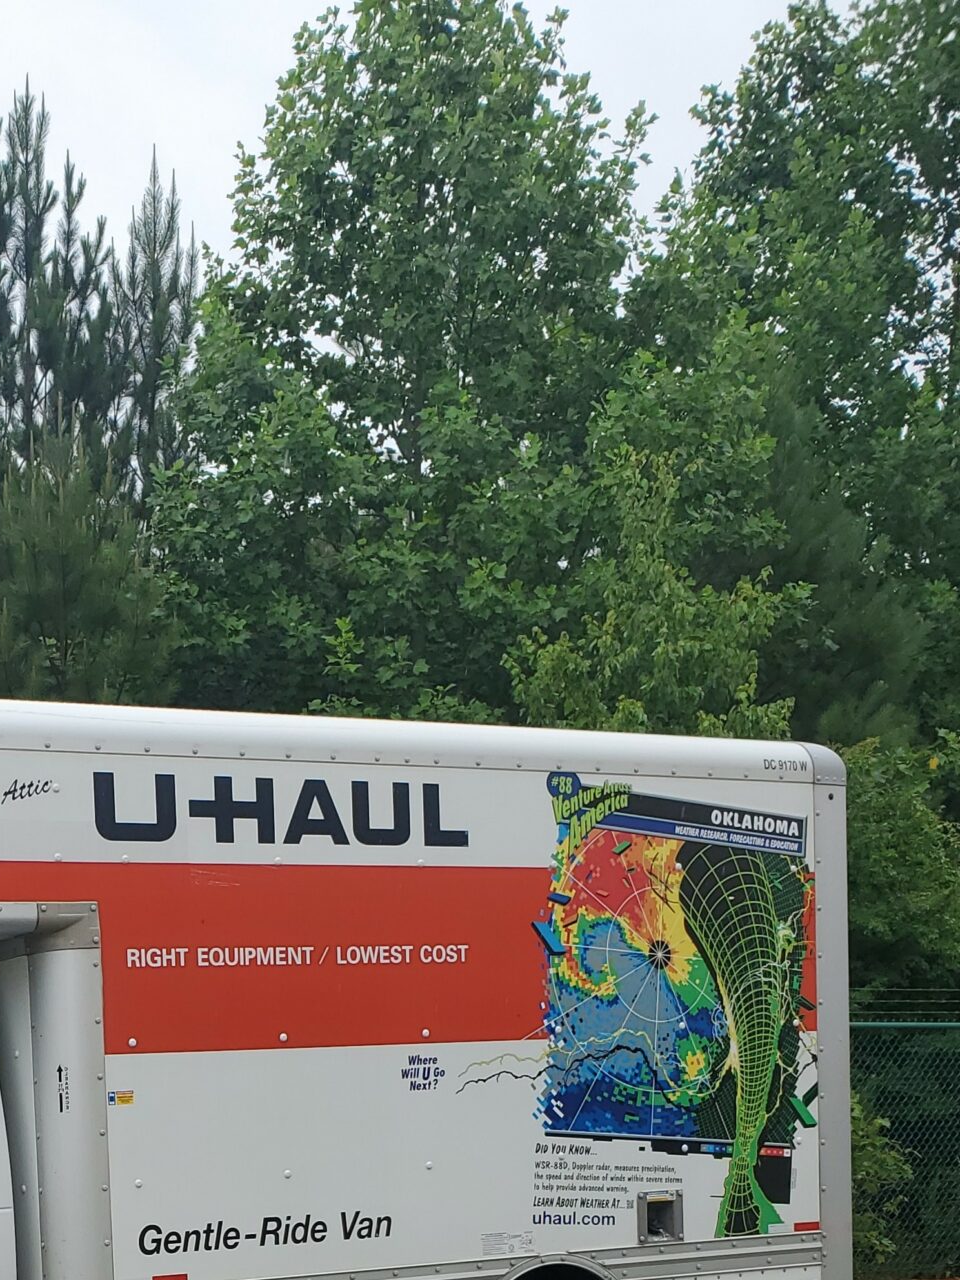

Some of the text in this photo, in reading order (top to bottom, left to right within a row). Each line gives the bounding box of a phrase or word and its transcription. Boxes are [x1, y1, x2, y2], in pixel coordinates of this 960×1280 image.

[764, 759, 808, 772] DC 9170 W
[1, 779, 51, 805] Attic
[551, 776, 573, 794] #88
[552, 787, 602, 823] Venture
[570, 794, 629, 854] America
[711, 810, 799, 836] OKLAHOMA
[675, 826, 700, 837] WEATHER
[126, 948, 188, 969] RIGHT
[197, 946, 312, 967] EQUIPMENT
[336, 945, 414, 965] LOWEST
[420, 944, 469, 963] COST
[408, 1054, 438, 1065] Where
[401, 1067, 446, 1080] Will U Go
[535, 1143, 548, 1154] DID
[551, 1143, 566, 1154] YOU
[533, 1196, 554, 1207] LEARN
[556, 1196, 578, 1208] ABOUT
[579, 1197, 610, 1208] WEATHER
[532, 1211, 616, 1226] uhaul.com
[139, 1211, 392, 1256] Gentle-Ride Van
